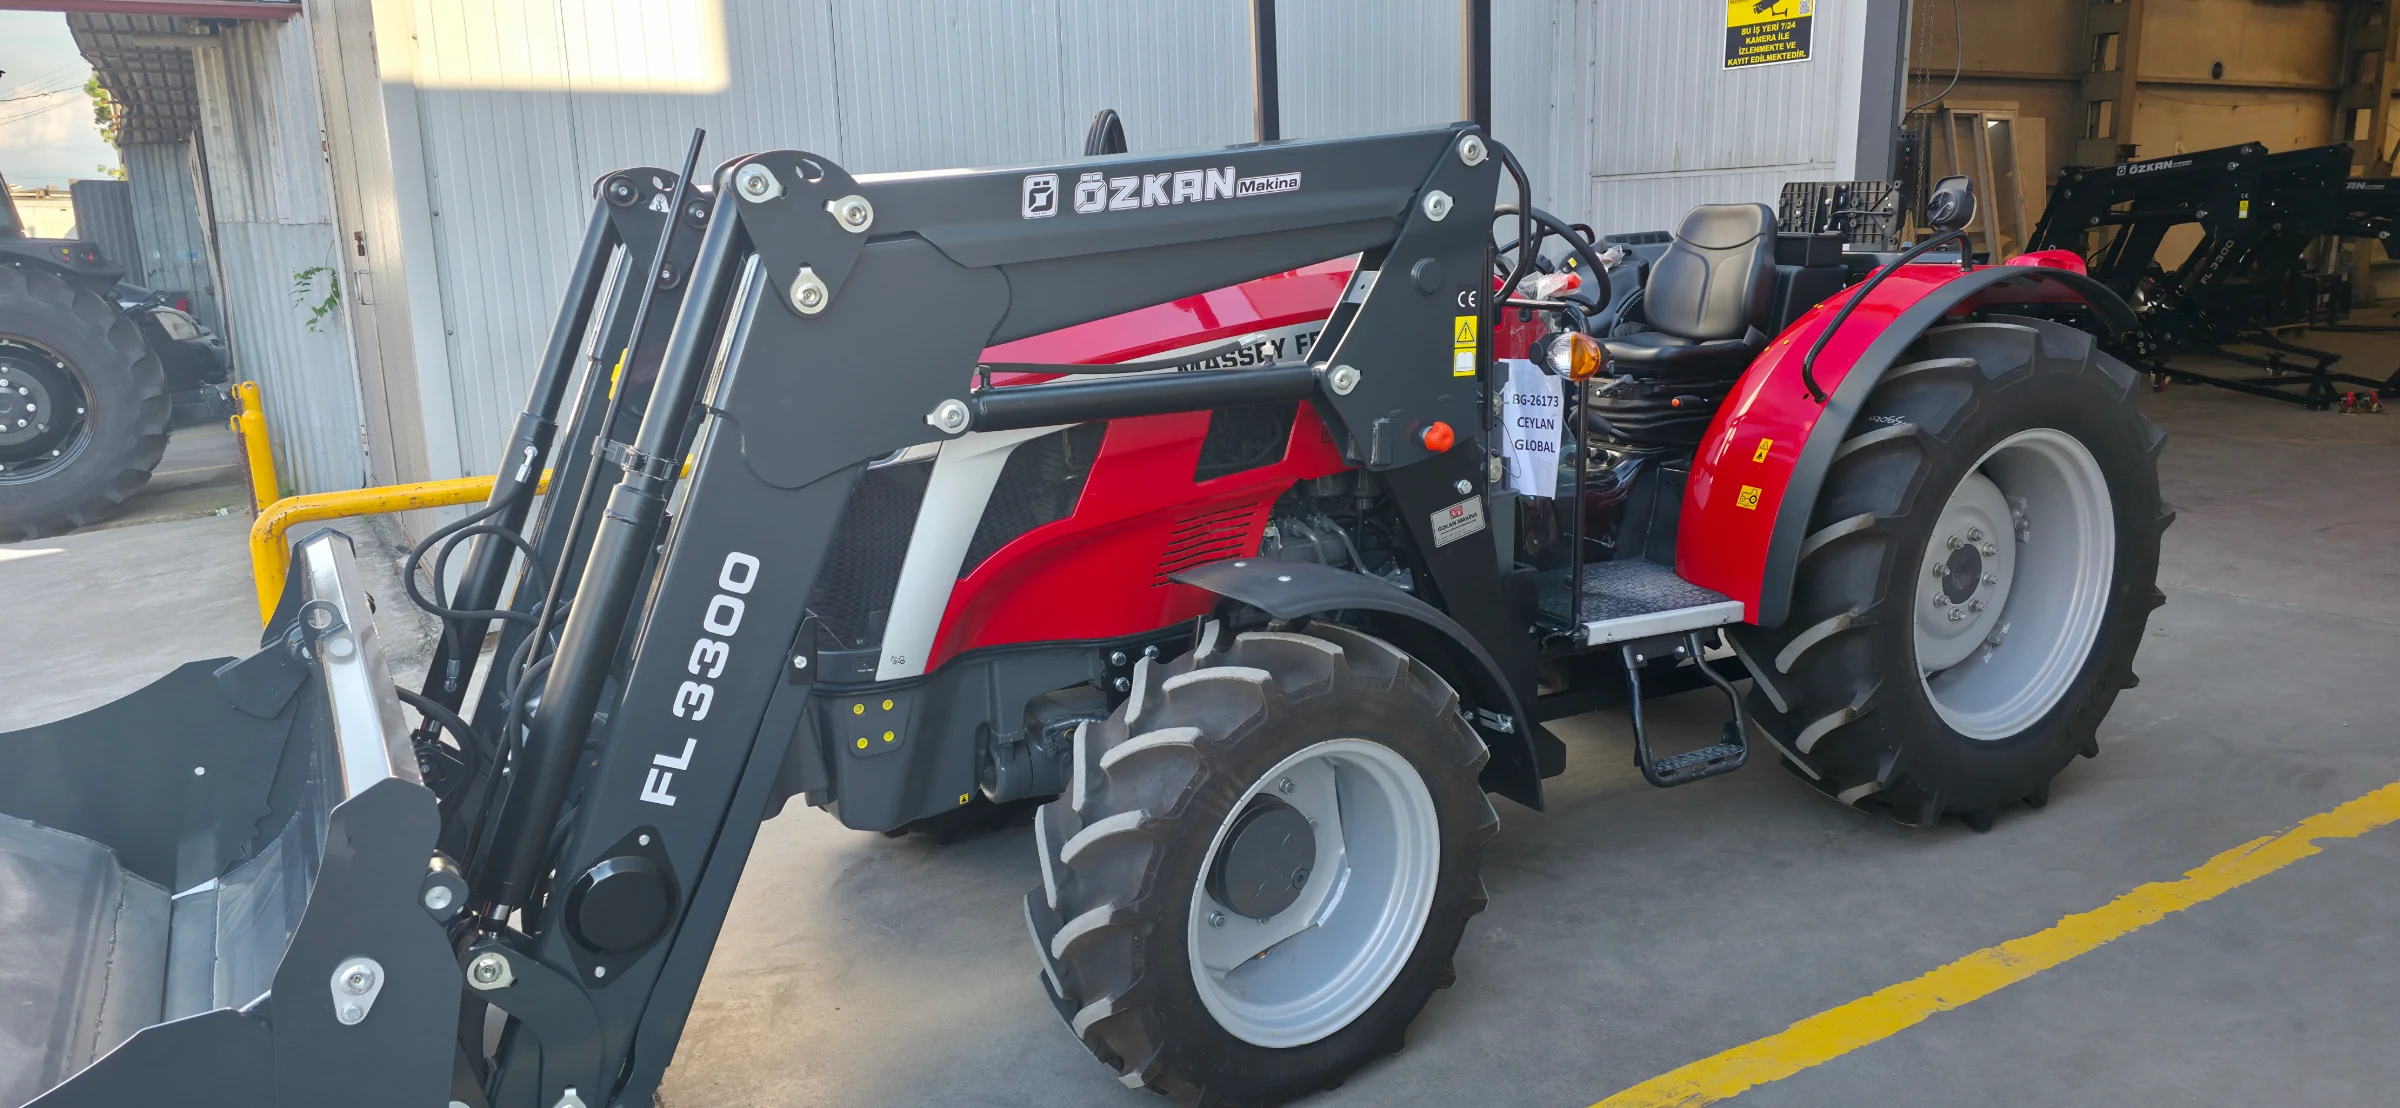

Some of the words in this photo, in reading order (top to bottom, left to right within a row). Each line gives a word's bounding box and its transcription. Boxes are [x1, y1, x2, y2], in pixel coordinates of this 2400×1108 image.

[1753, 25, 1760, 34] İŞ
[1762, 22, 1779, 32] YERİ
[1781, 21, 1796, 29] 7/24
[1746, 34, 1776, 44] KAMERA
[1778, 32, 1789, 40] İLE
[1738, 43, 1785, 55] İZLENMEKTE
[1786, 41, 1796, 49] VE
[1727, 57, 1749, 66] KAYIT
[1751, 49, 1806, 63] EDİLMEKTEDİR.
[2128, 160, 2173, 175] ÖZKAN
[1074, 166, 1236, 214] ÖZKAN
[1239, 176, 1299, 194] Makina
[2210, 240, 2234, 270] 3300
[1513, 394, 1559, 407] BG-26173
[1517, 417, 1554, 430] CEYLAN
[1514, 439, 1555, 453] GLOBAL
[640, 738, 697, 806] FL
[672, 552, 760, 721] 3300
